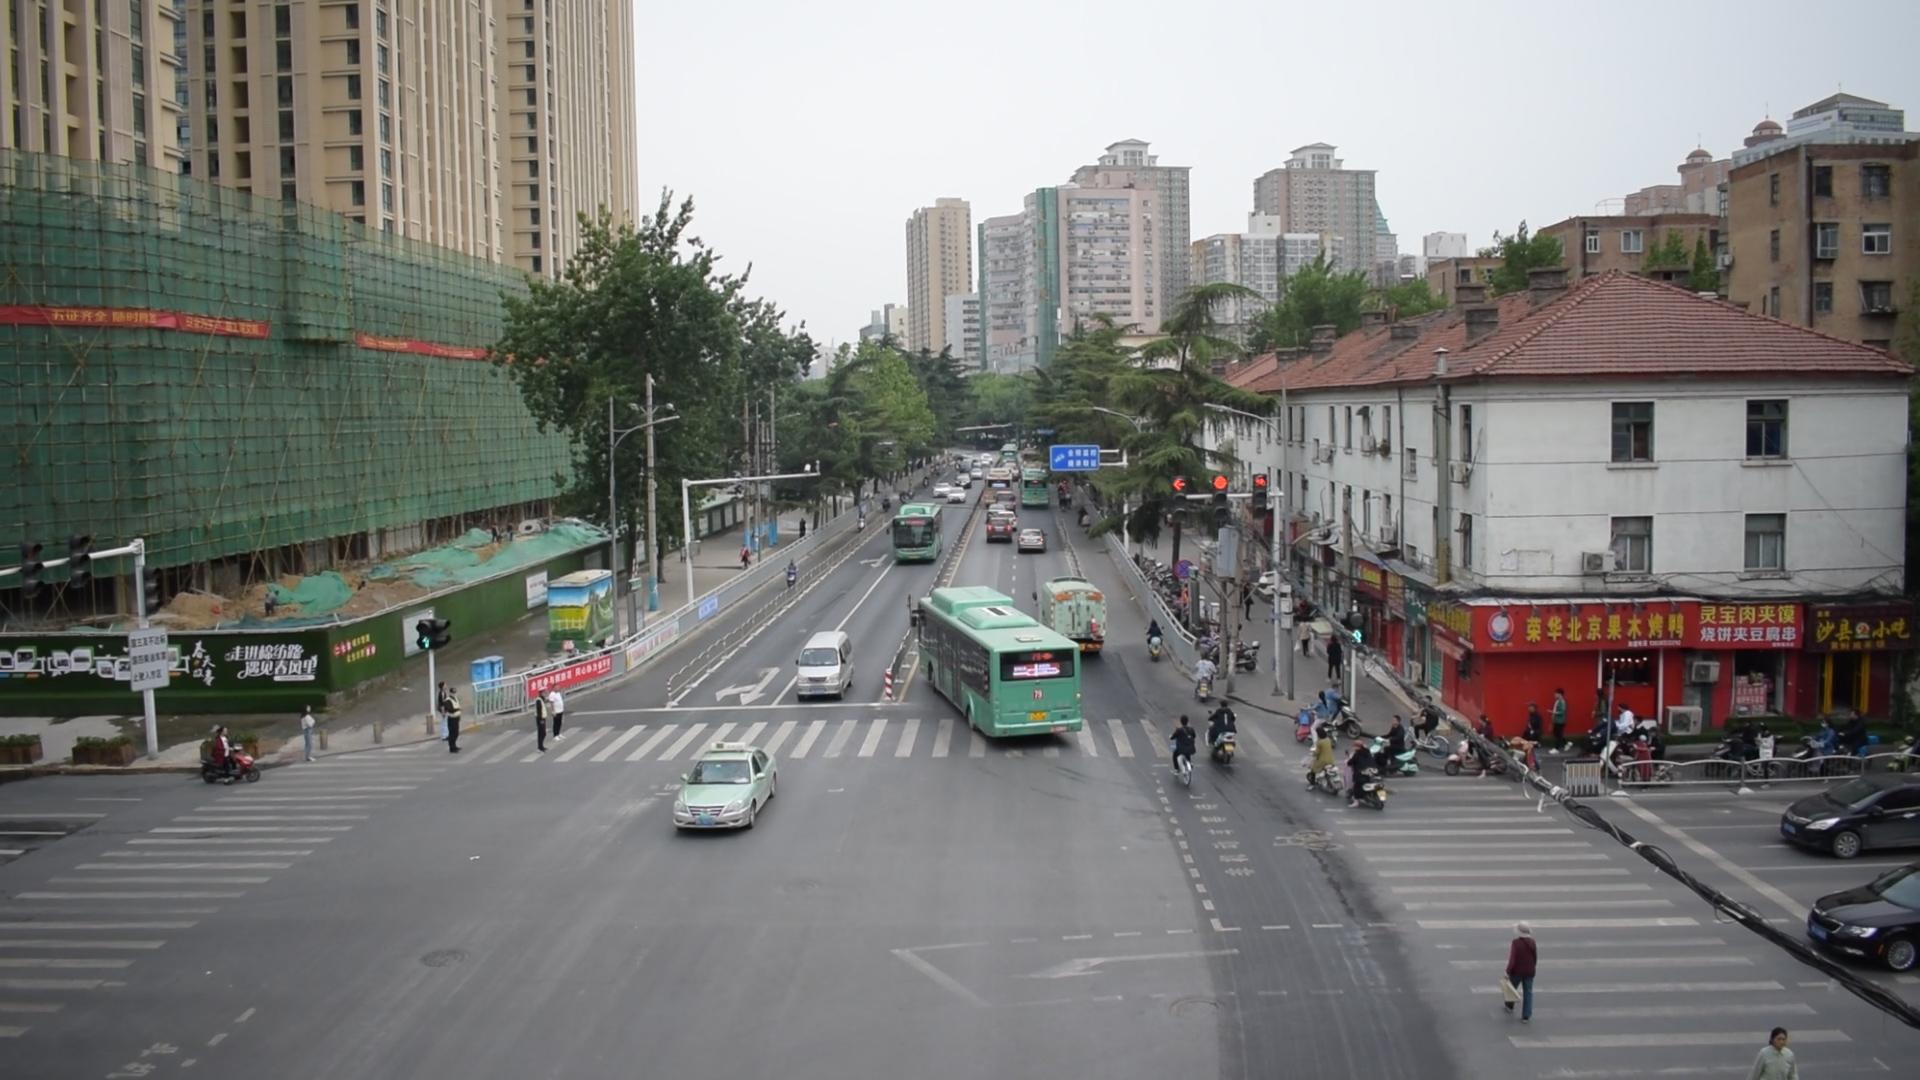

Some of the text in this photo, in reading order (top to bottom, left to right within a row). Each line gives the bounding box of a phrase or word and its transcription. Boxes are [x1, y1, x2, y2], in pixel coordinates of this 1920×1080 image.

[1700, 604, 1795, 624] 灵宝肉夹馍
[1526, 612, 1684, 643] 荣华北京果木烤鸭
[1700, 626, 1796, 642] 烧饼夹豆腐串
